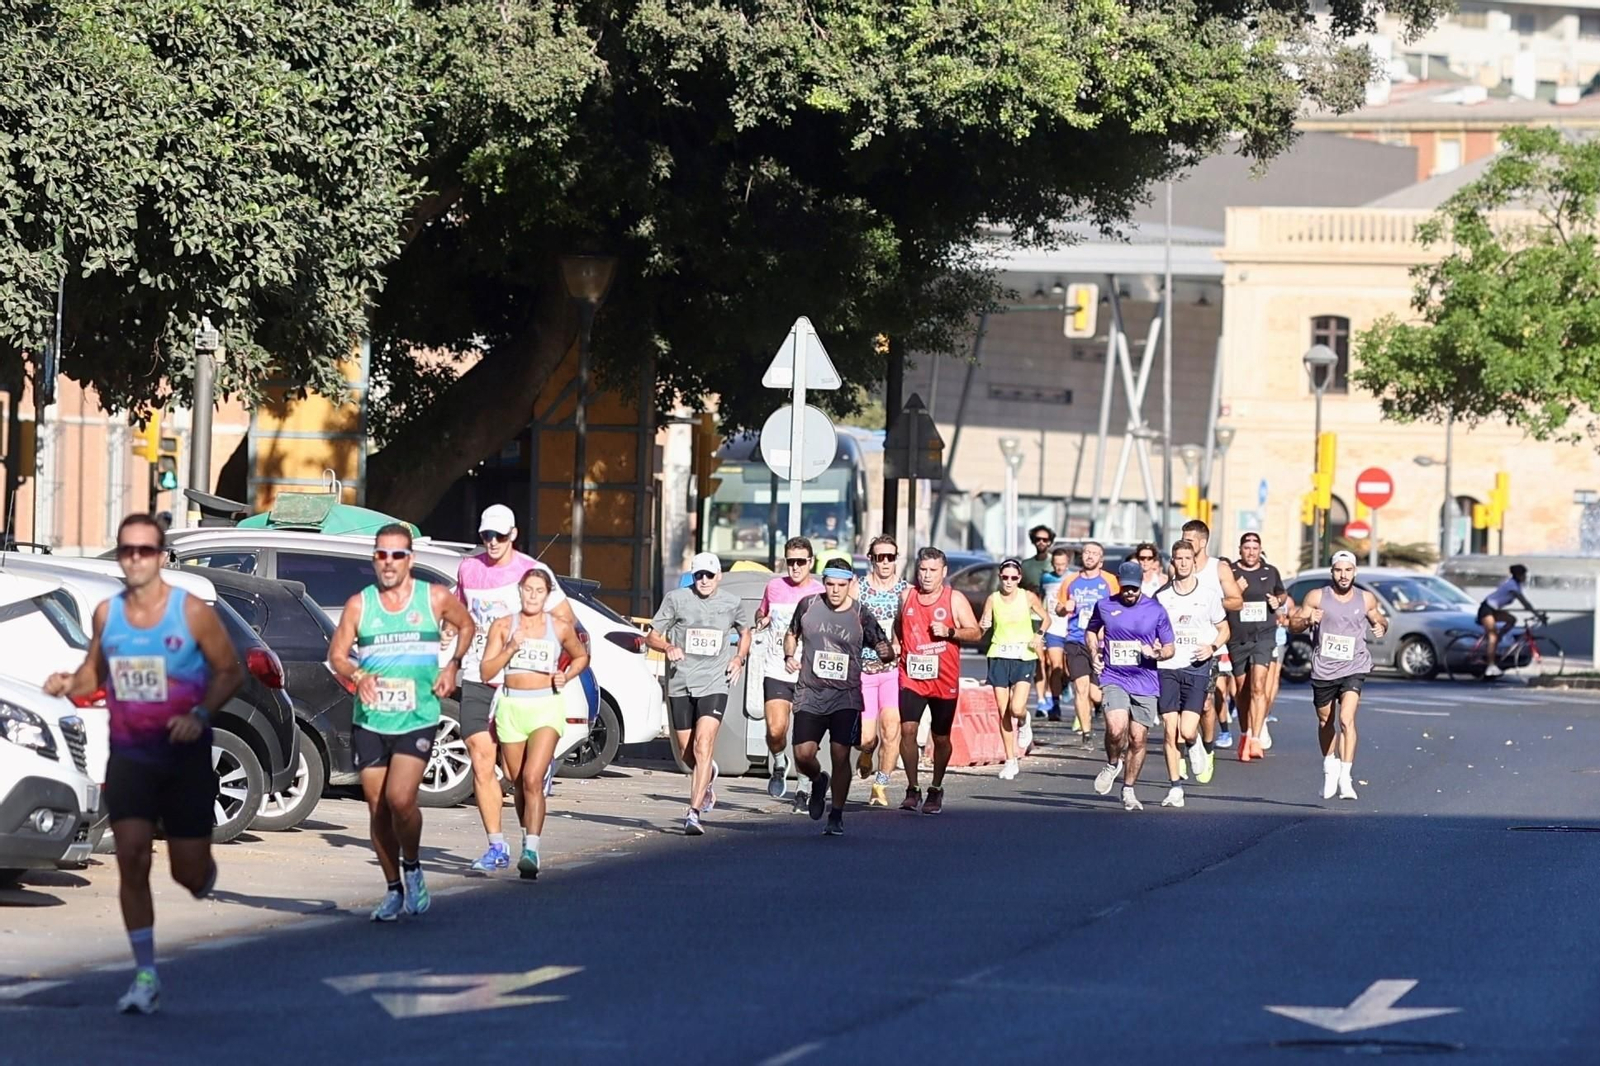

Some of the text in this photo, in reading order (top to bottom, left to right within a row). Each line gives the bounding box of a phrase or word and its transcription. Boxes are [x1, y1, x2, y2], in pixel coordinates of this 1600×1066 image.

[373, 632, 421, 645] ATLETISMO
[692, 637, 716, 648] 384
[1176, 637, 1197, 645] 498
[1327, 642, 1349, 653] 745
[517, 648, 549, 662] 269
[1113, 649, 1136, 658] 513
[818, 660, 844, 672] 636
[911, 663, 933, 672] 746
[121, 670, 158, 687] 196
[377, 690, 407, 702] 173
